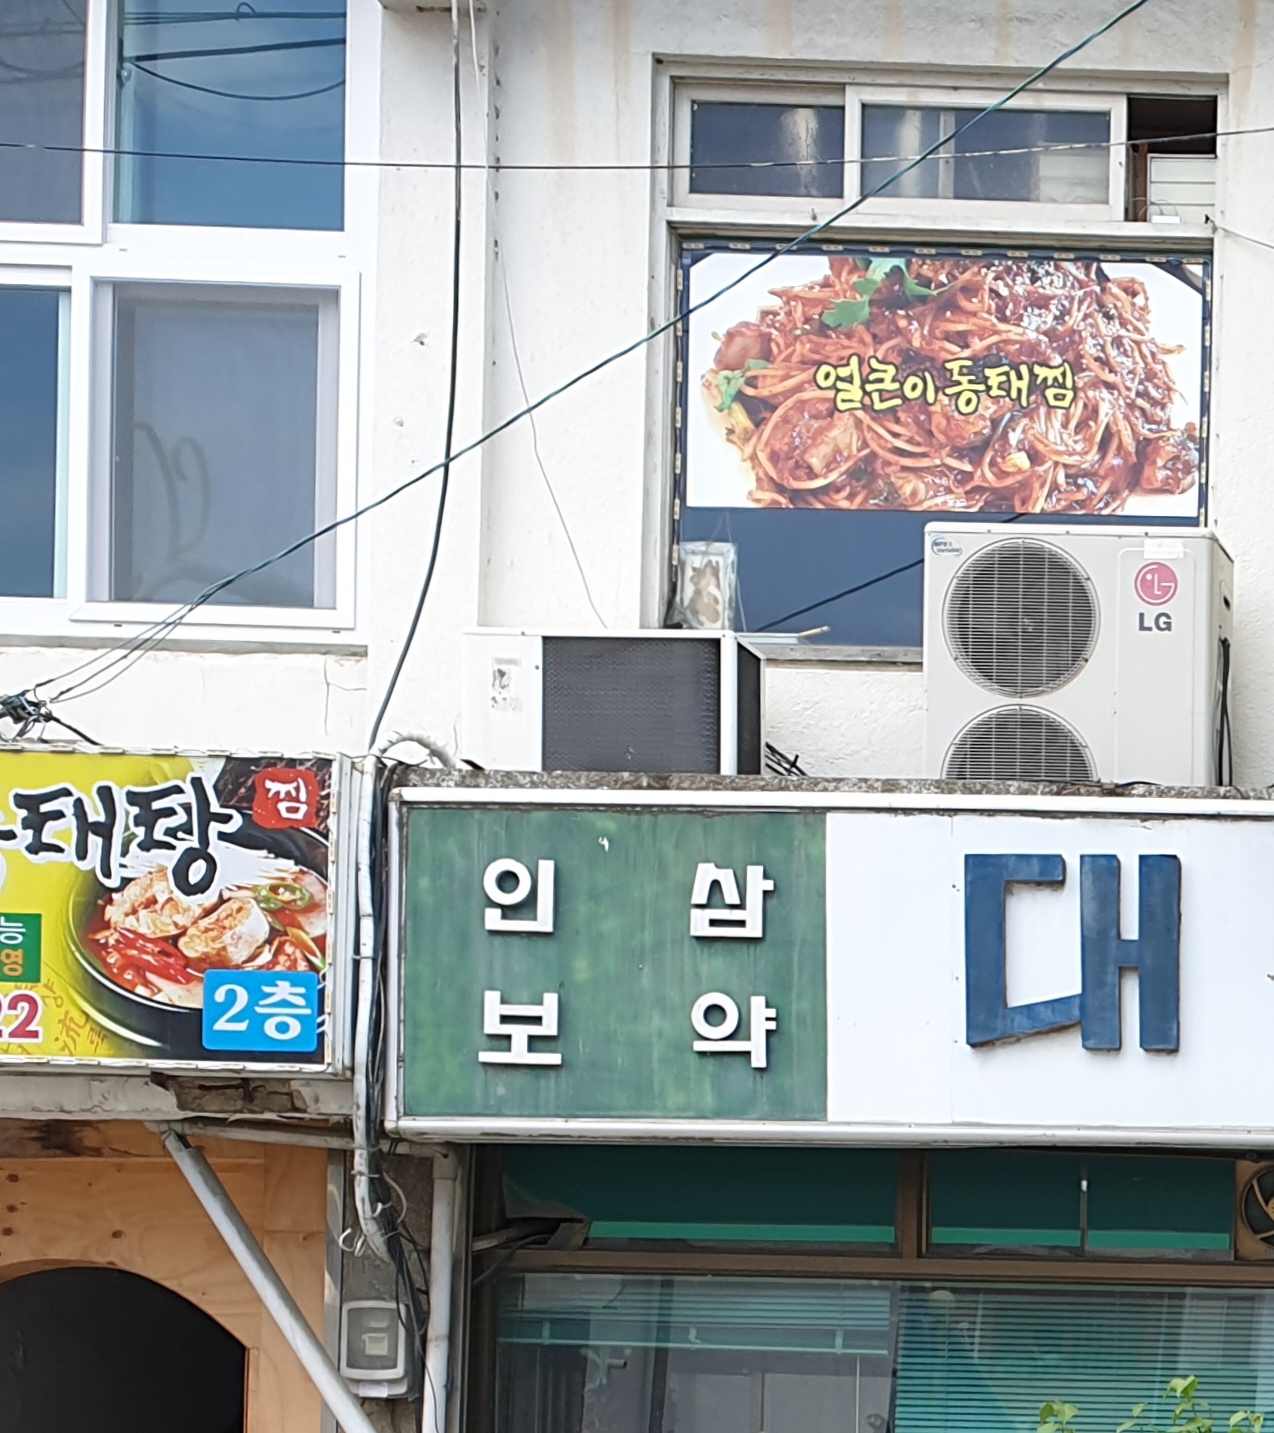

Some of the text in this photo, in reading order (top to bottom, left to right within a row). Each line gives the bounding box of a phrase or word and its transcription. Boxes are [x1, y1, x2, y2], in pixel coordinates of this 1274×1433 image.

[815, 354, 1075, 414] 얼큰이 동태찜
[1138, 612, 1173, 632] LG
[264, 778, 309, 821] 찜
[0, 777, 234, 896] 태탕
[212, 980, 312, 1041] 2층
